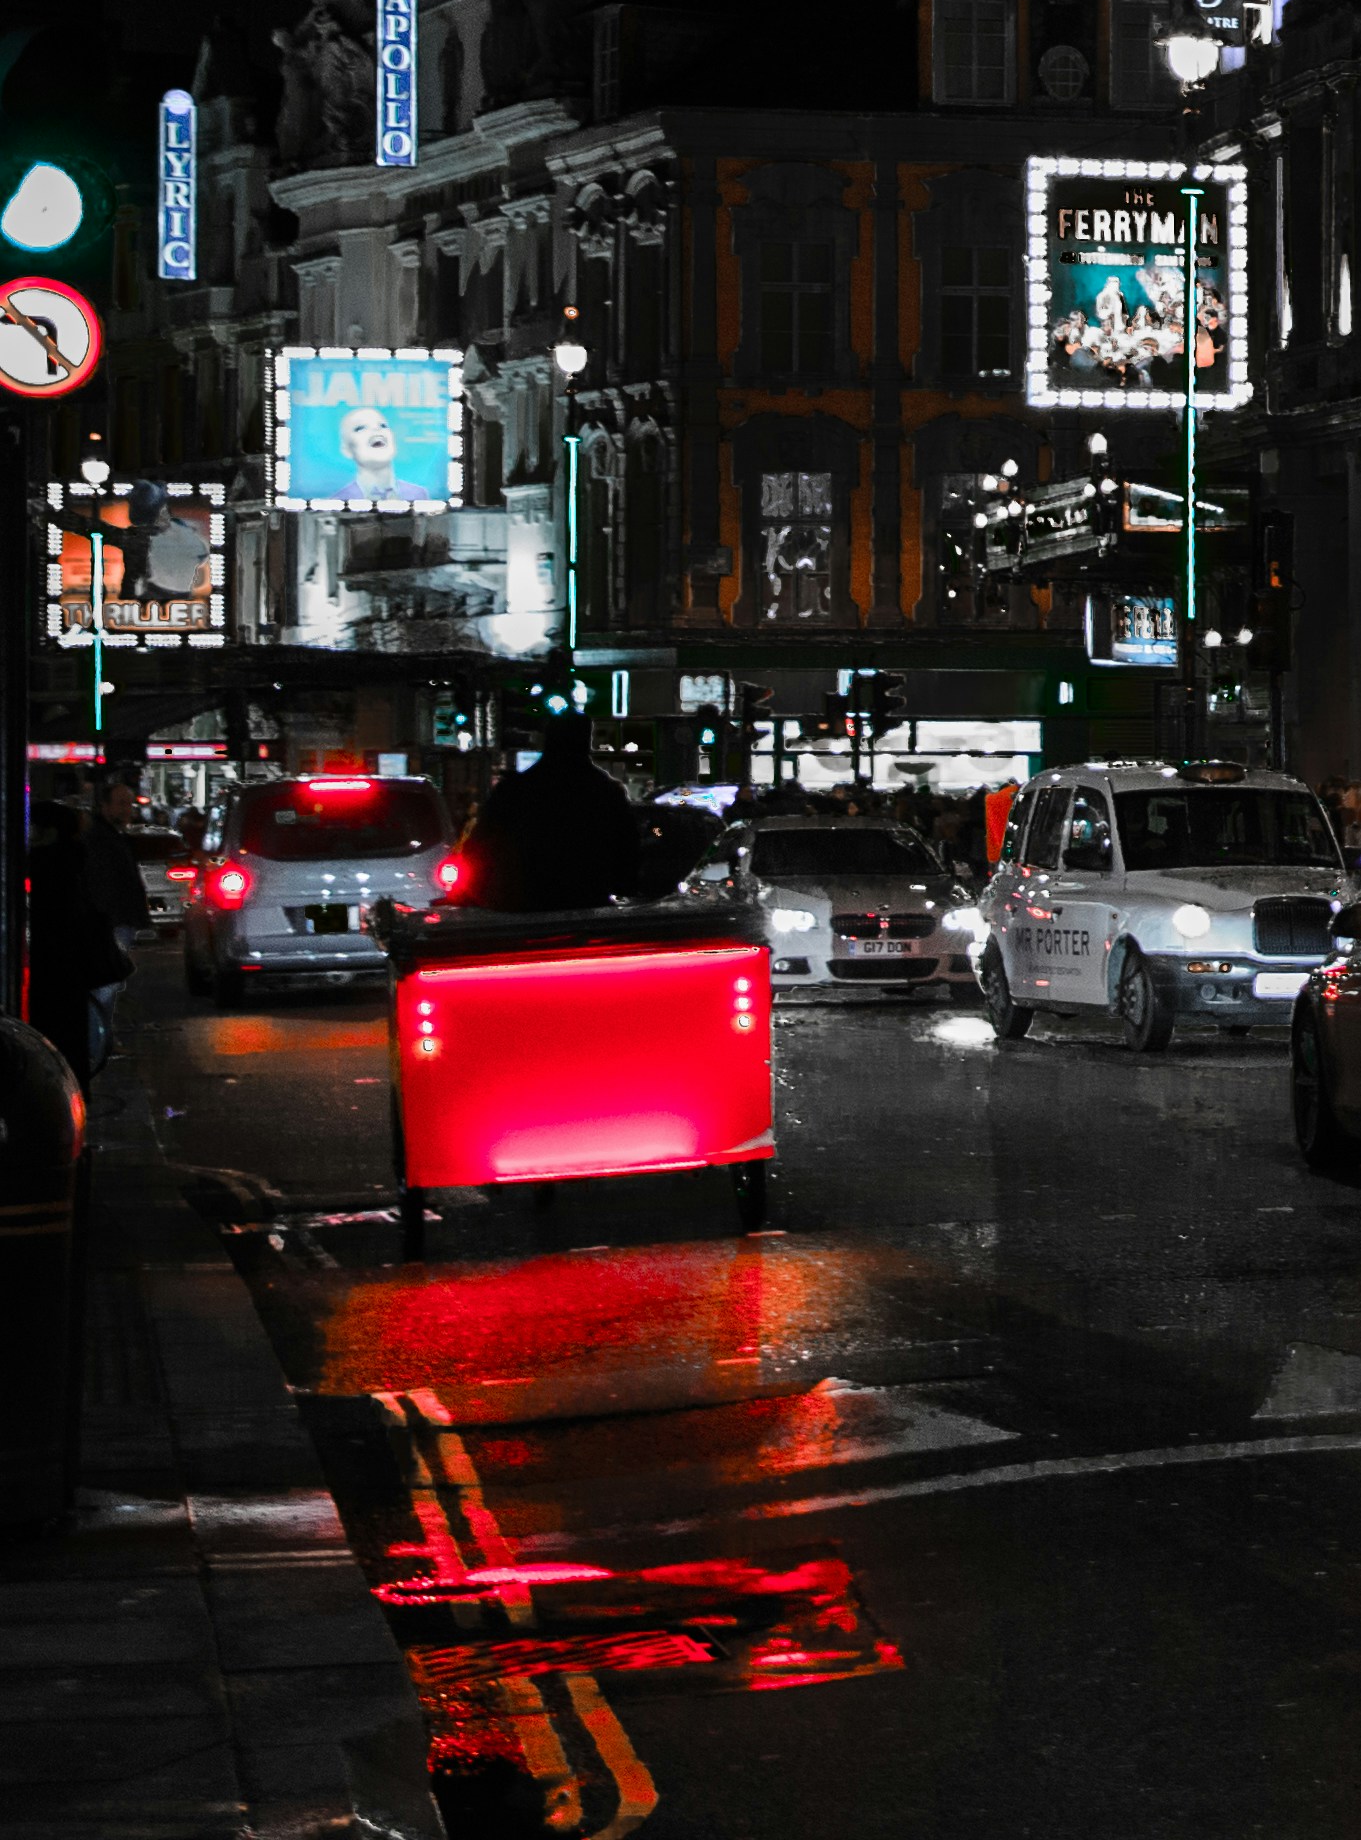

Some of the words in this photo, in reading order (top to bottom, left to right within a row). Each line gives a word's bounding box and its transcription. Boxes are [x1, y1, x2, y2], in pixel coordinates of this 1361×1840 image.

[162, 122, 190, 268] LYRIC
[1124, 189, 1155, 207] THE
[292, 371, 449, 407] JAMIE
[1037, 928, 1091, 956] PORTER
